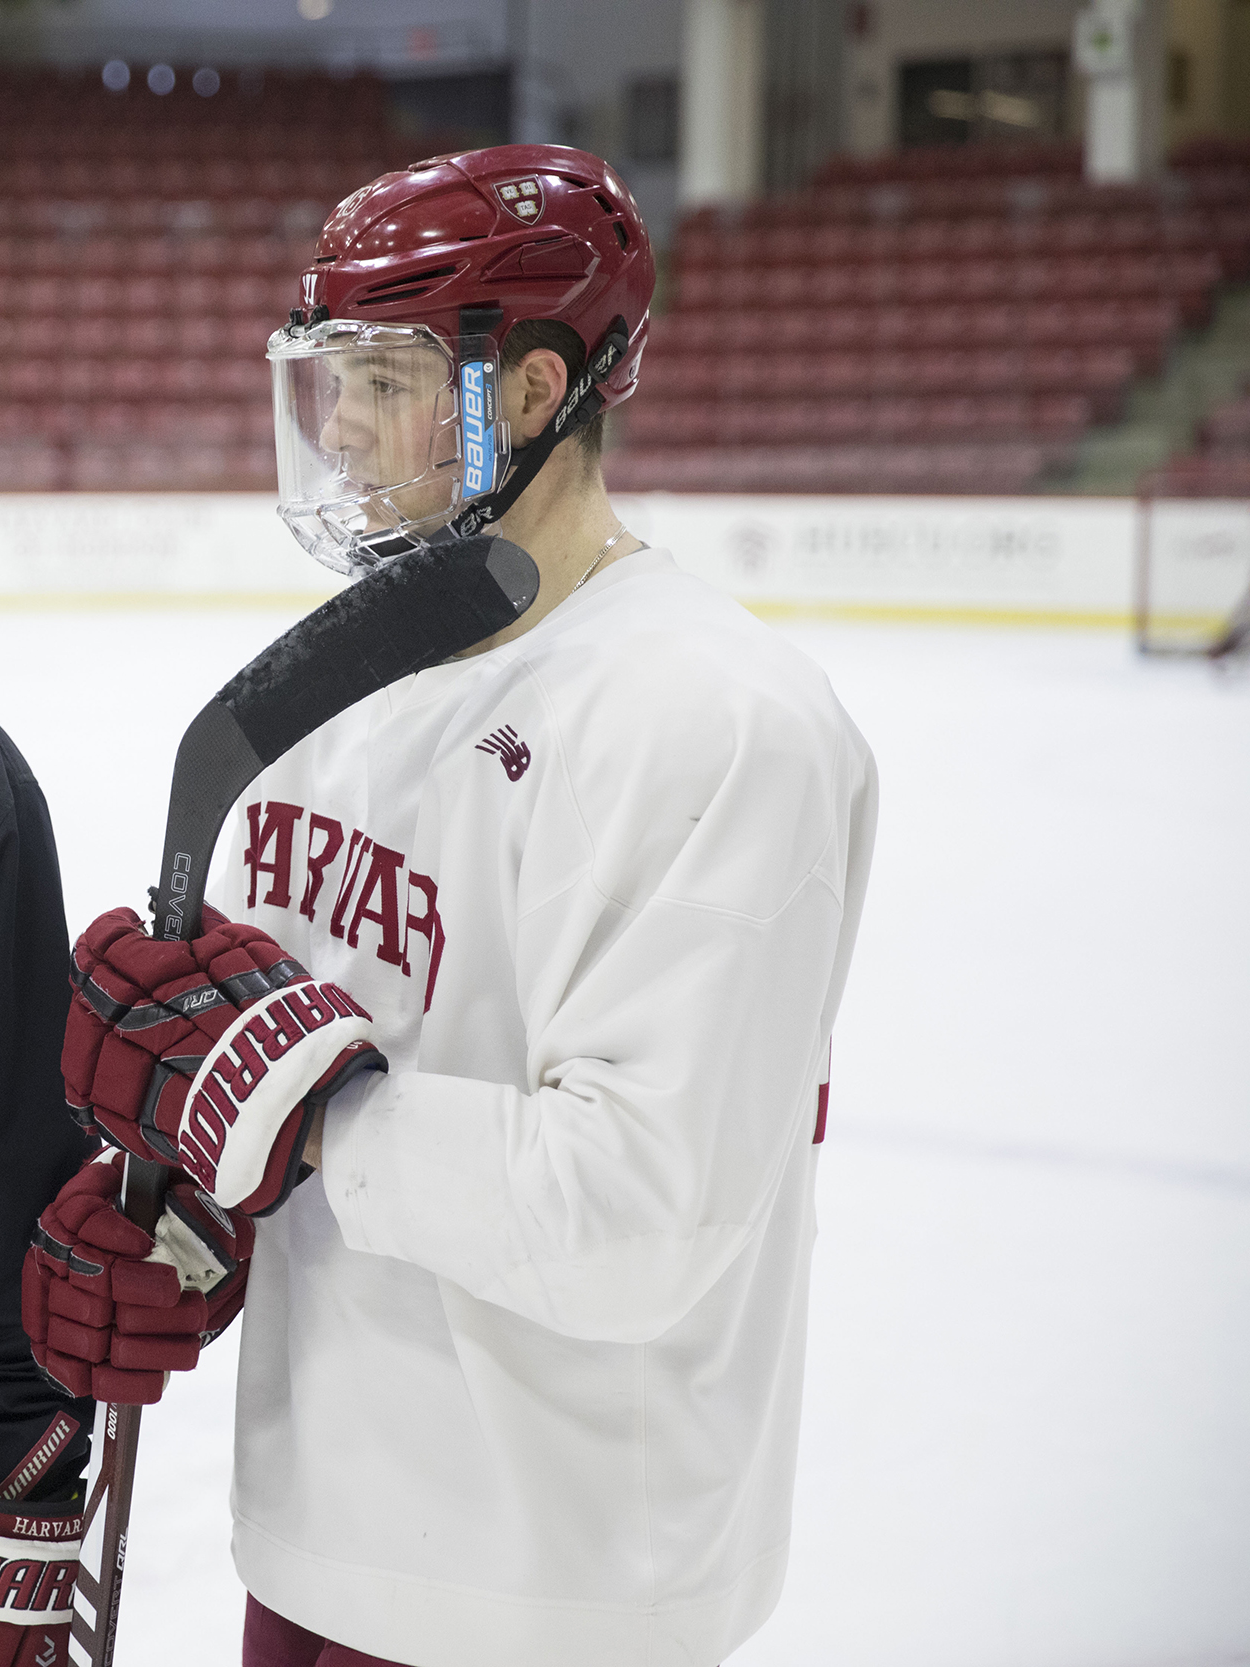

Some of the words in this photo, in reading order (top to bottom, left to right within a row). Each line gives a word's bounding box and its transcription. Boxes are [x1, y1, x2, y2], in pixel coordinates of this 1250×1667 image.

[464, 366, 484, 491] BAUER
[177, 982, 375, 1195] WARRIOR
[12, 1516, 85, 1537] HARVAR
